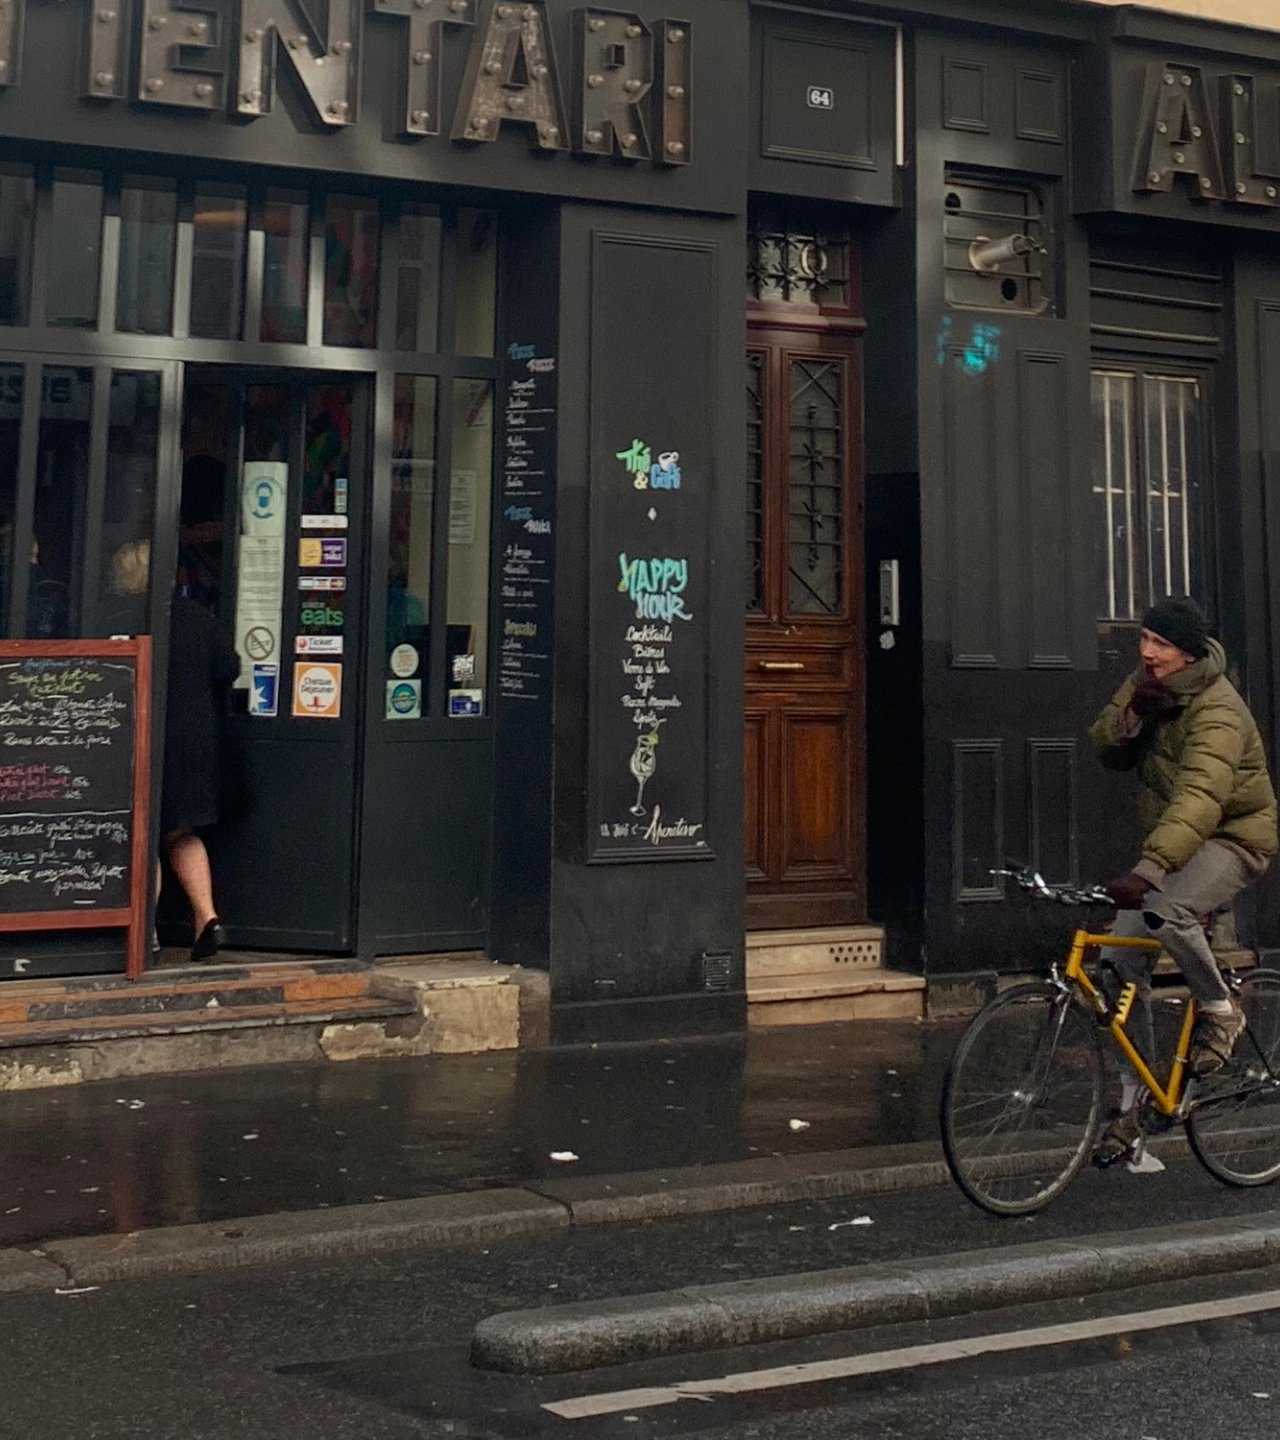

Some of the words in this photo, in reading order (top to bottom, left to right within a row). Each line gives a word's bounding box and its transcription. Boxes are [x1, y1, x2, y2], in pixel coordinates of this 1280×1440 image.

[810, 90, 830, 106] 64
[302, 608, 344, 626] eats
[624, 624, 673, 642] Cocktails
